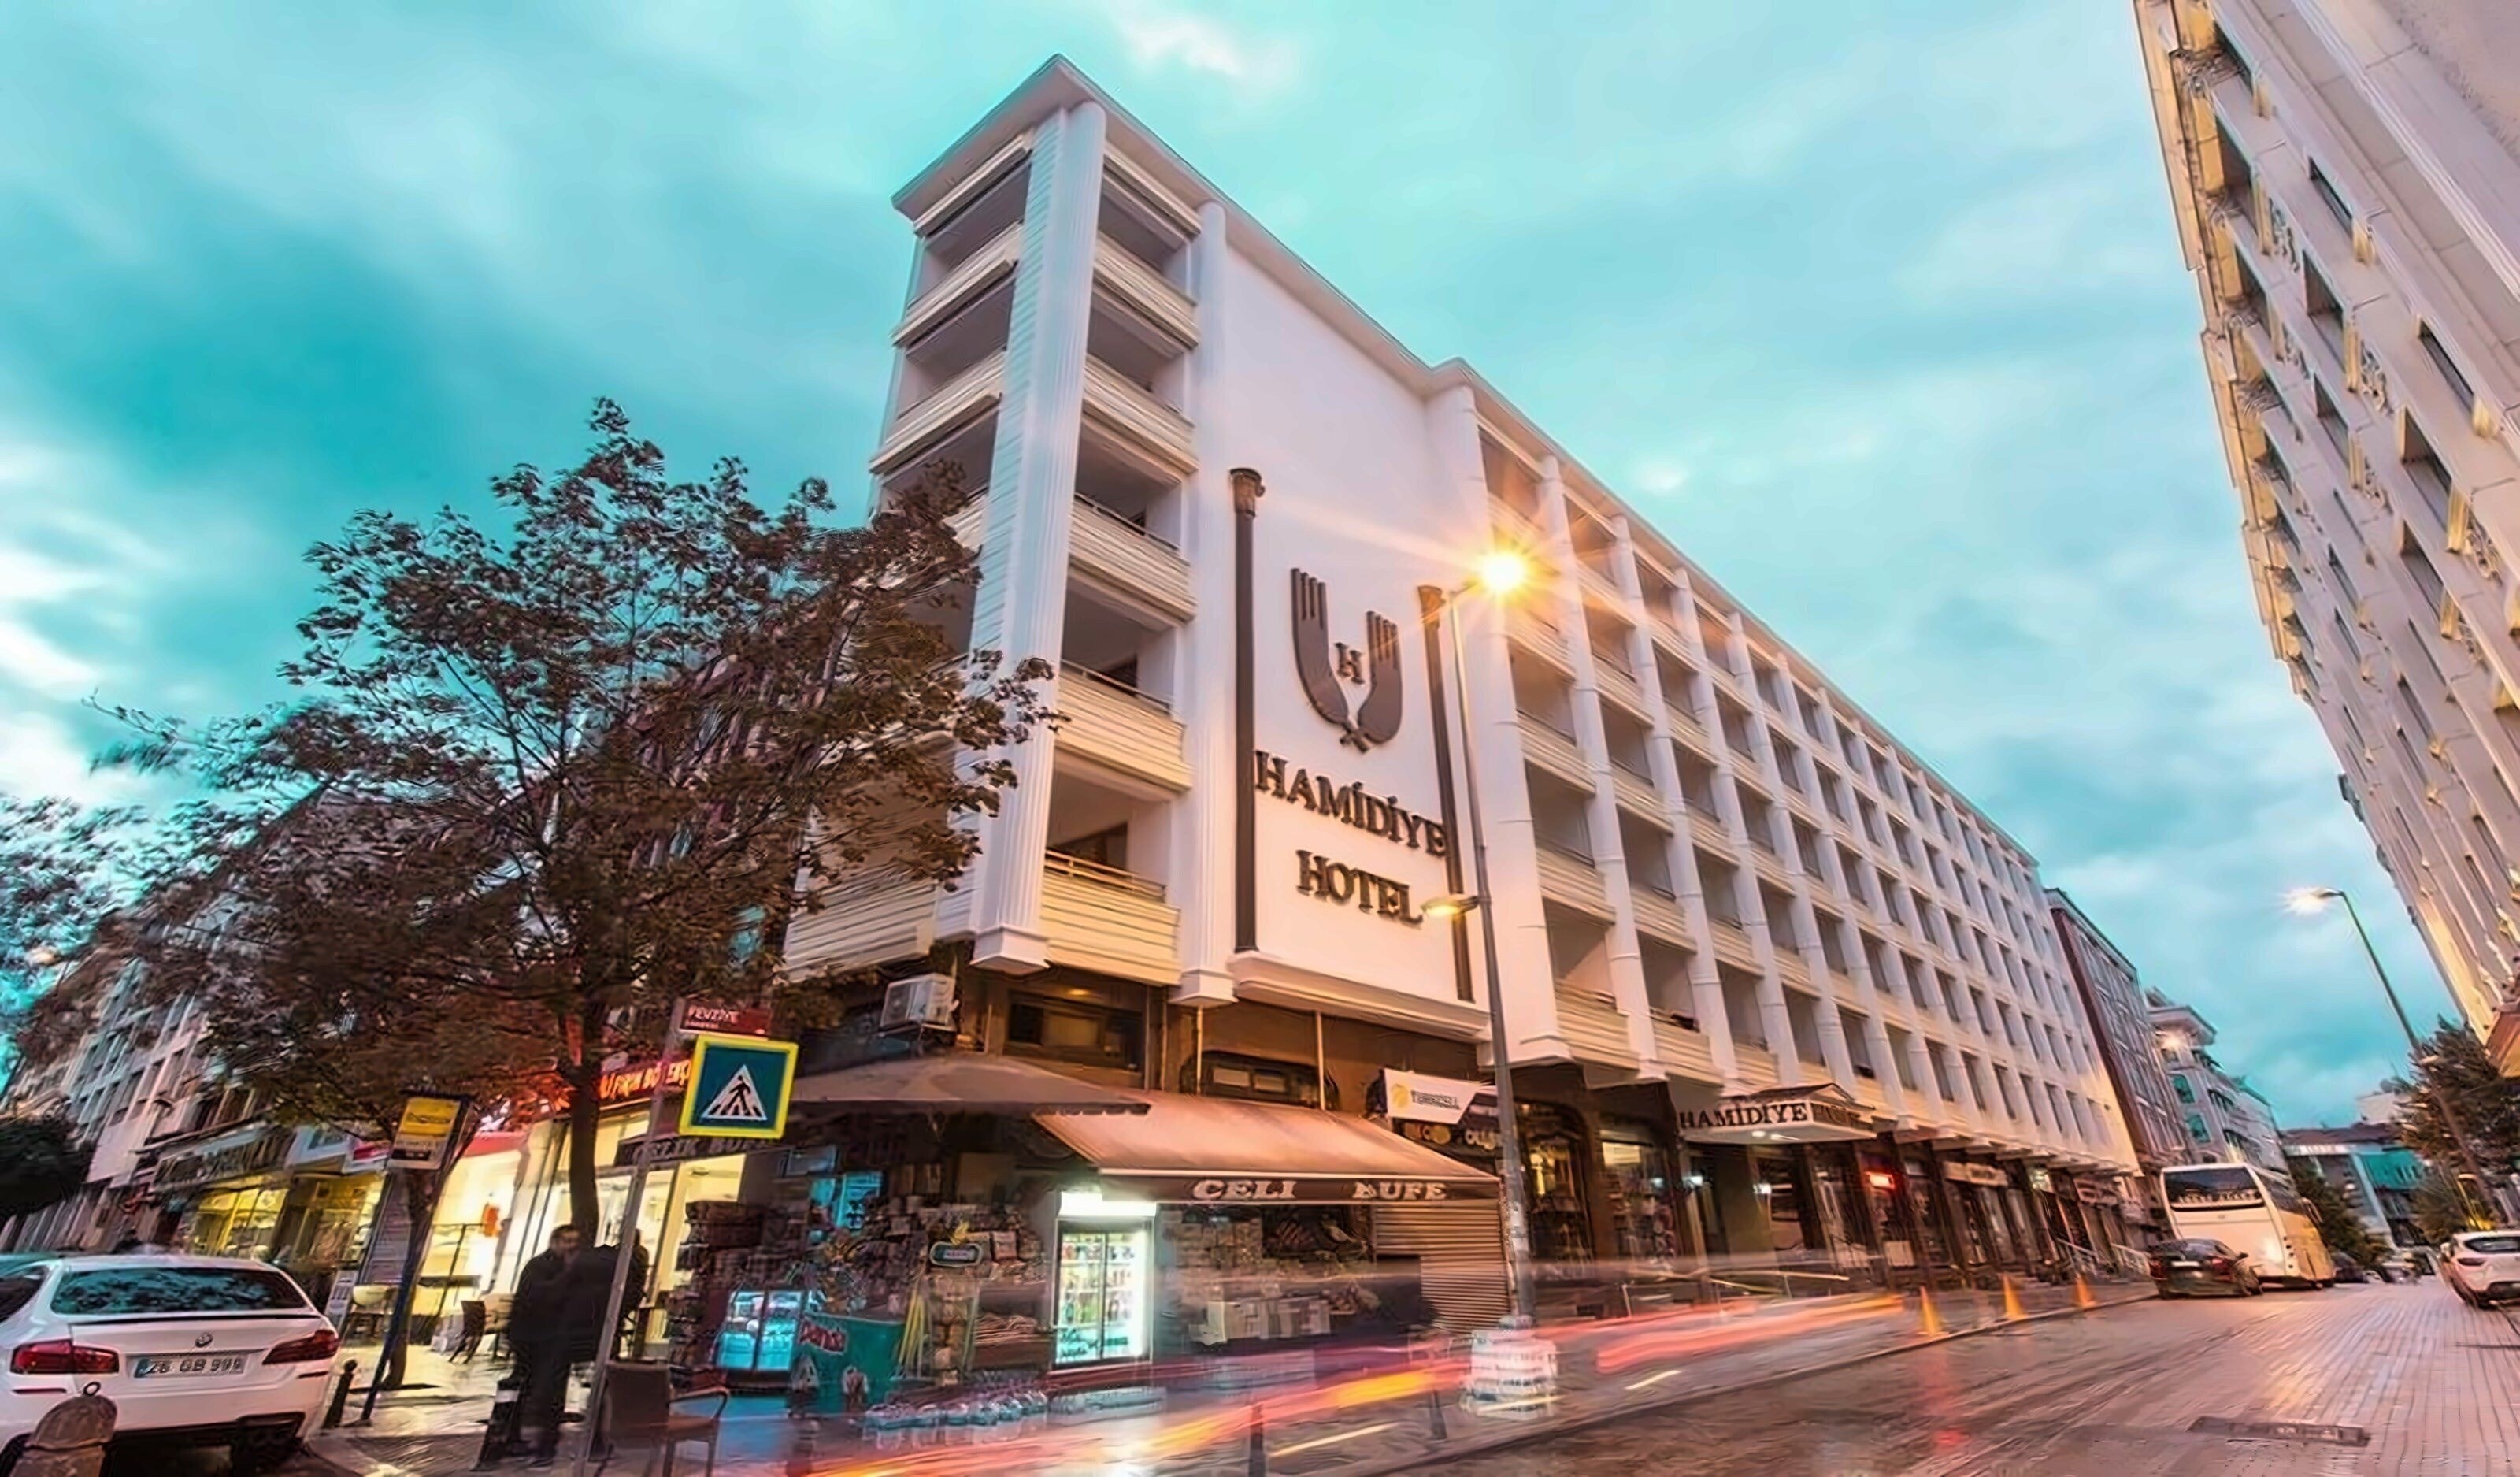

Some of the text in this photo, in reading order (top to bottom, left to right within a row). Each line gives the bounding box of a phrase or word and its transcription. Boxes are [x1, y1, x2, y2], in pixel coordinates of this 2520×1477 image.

[1335, 641, 1366, 685] H
[1255, 749, 1448, 858] HAMİDİYE
[1295, 849, 1424, 925] HOTEL
